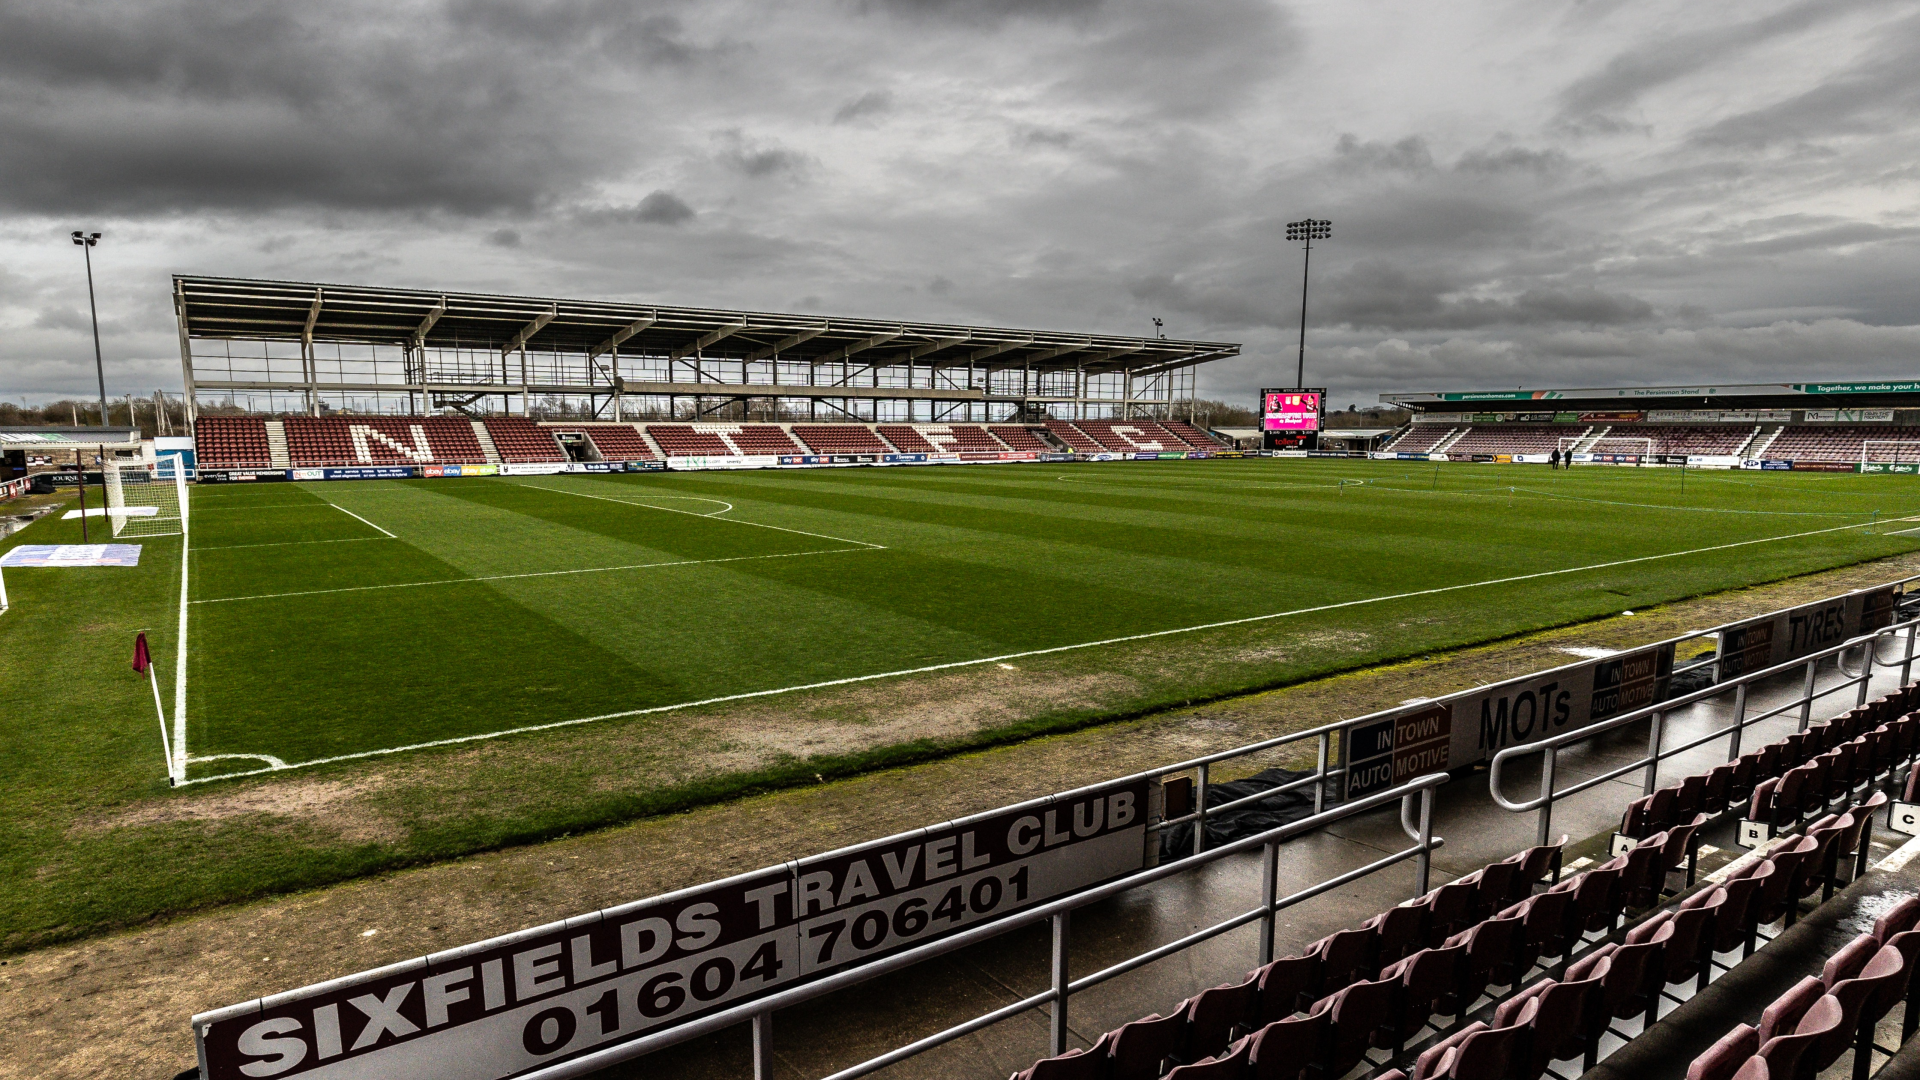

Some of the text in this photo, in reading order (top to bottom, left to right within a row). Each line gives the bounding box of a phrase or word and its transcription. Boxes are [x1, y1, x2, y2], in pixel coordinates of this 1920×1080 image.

[1817, 385, 1852, 393] Together,
[1893, 384, 1912, 392] your
[1737, 628, 1768, 648] IN TOWN
[1789, 604, 1845, 651] TYRES
[1611, 659, 1650, 683] IN TOWN
[1723, 649, 1770, 675] AUTO MOTIVE
[1592, 683, 1653, 713] AUTO MOTIVE
[1479, 682, 1571, 751] MOTs
[1377, 716, 1439, 750] IN TOWN
[1350, 745, 1449, 792] AUTO MOTIVE
[1902, 814, 1915, 825] C
[1748, 829, 1759, 839] B
[1620, 844, 1629, 853] A
[237, 791, 1136, 1078] SIXFIELDS TRAVEL CLUB
[522, 867, 1029, 1056] 01604 706401
